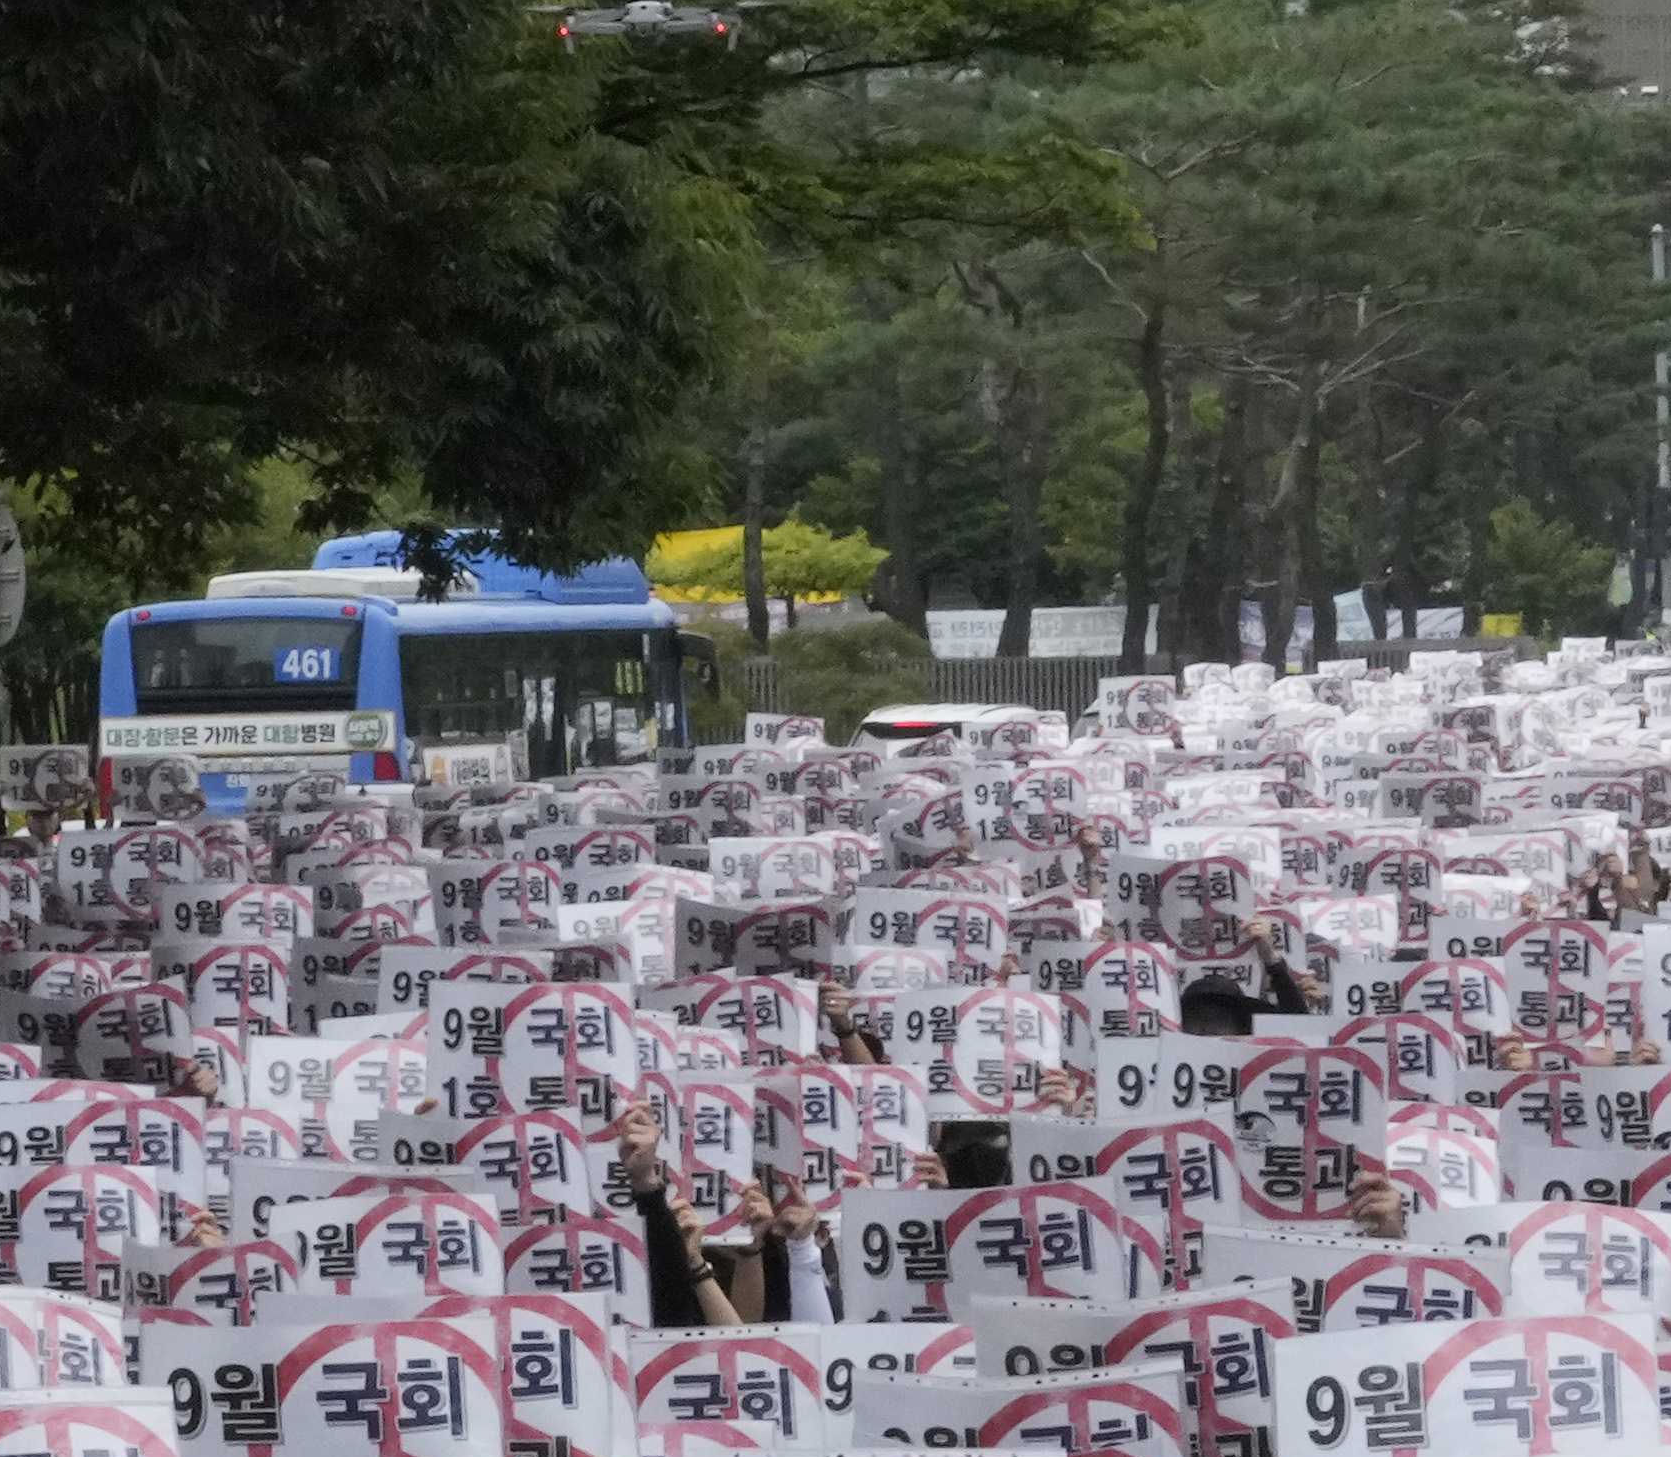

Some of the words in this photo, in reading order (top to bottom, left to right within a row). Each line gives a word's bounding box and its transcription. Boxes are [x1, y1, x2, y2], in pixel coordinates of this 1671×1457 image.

[282, 648, 330, 679] 461
[204, 725, 257, 745] 가까운
[868, 909, 920, 942] 9월
[934, 911, 995, 948] 국회
[17, 1011, 79, 1048] 9월
[99, 1001, 170, 1044] 국회
[442, 1005, 505, 1050] 9월
[527, 1006, 616, 1054] 국회
[1304, 1360, 1429, 1450] 9월
[1463, 1352, 1619, 1438] 국회
